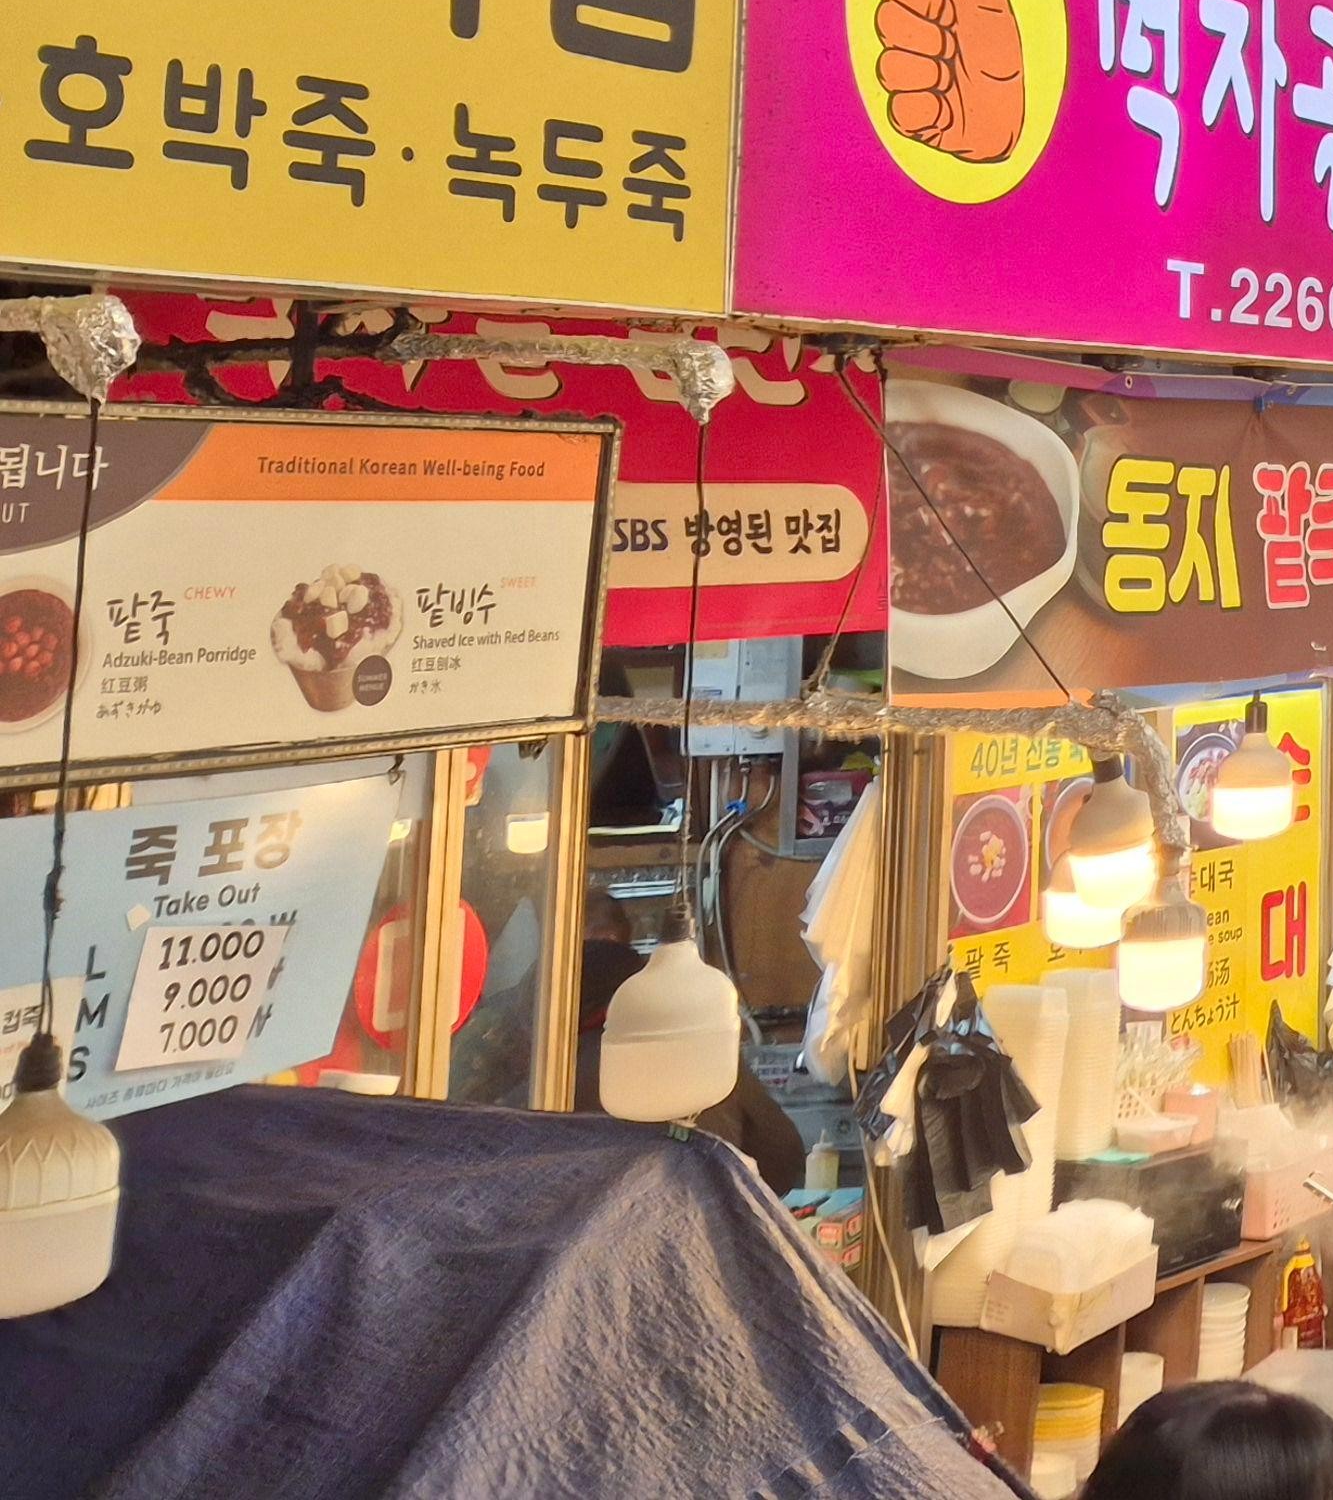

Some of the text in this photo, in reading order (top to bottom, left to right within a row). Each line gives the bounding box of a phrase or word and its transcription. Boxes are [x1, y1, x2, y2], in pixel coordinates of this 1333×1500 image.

[257, 456, 546, 481] Traditional Korean Well-being Food
[611, 508, 841, 557] SBS 방영된 맛집
[1101, 456, 1242, 615] 동지
[184, 586, 237, 601] CHEWY
[500, 576, 536, 589] SWEET
[106, 589, 176, 646] 팥죽
[415, 583, 497, 628] 팥빙수
[102, 645, 257, 669] Adzuki-Bean Porridge
[412, 629, 560, 650] Shaved Ice with Red Beans
[970, 738, 1018, 778] 40년
[124, 810, 304, 886] 죽 포장
[153, 882, 261, 919] Take Out
[158, 929, 265, 971] 11.000
[1217, 926, 1243, 945] soup
[74, 973, 252, 1033] M 9.000
[66, 1014, 239, 1083] S 7.000
